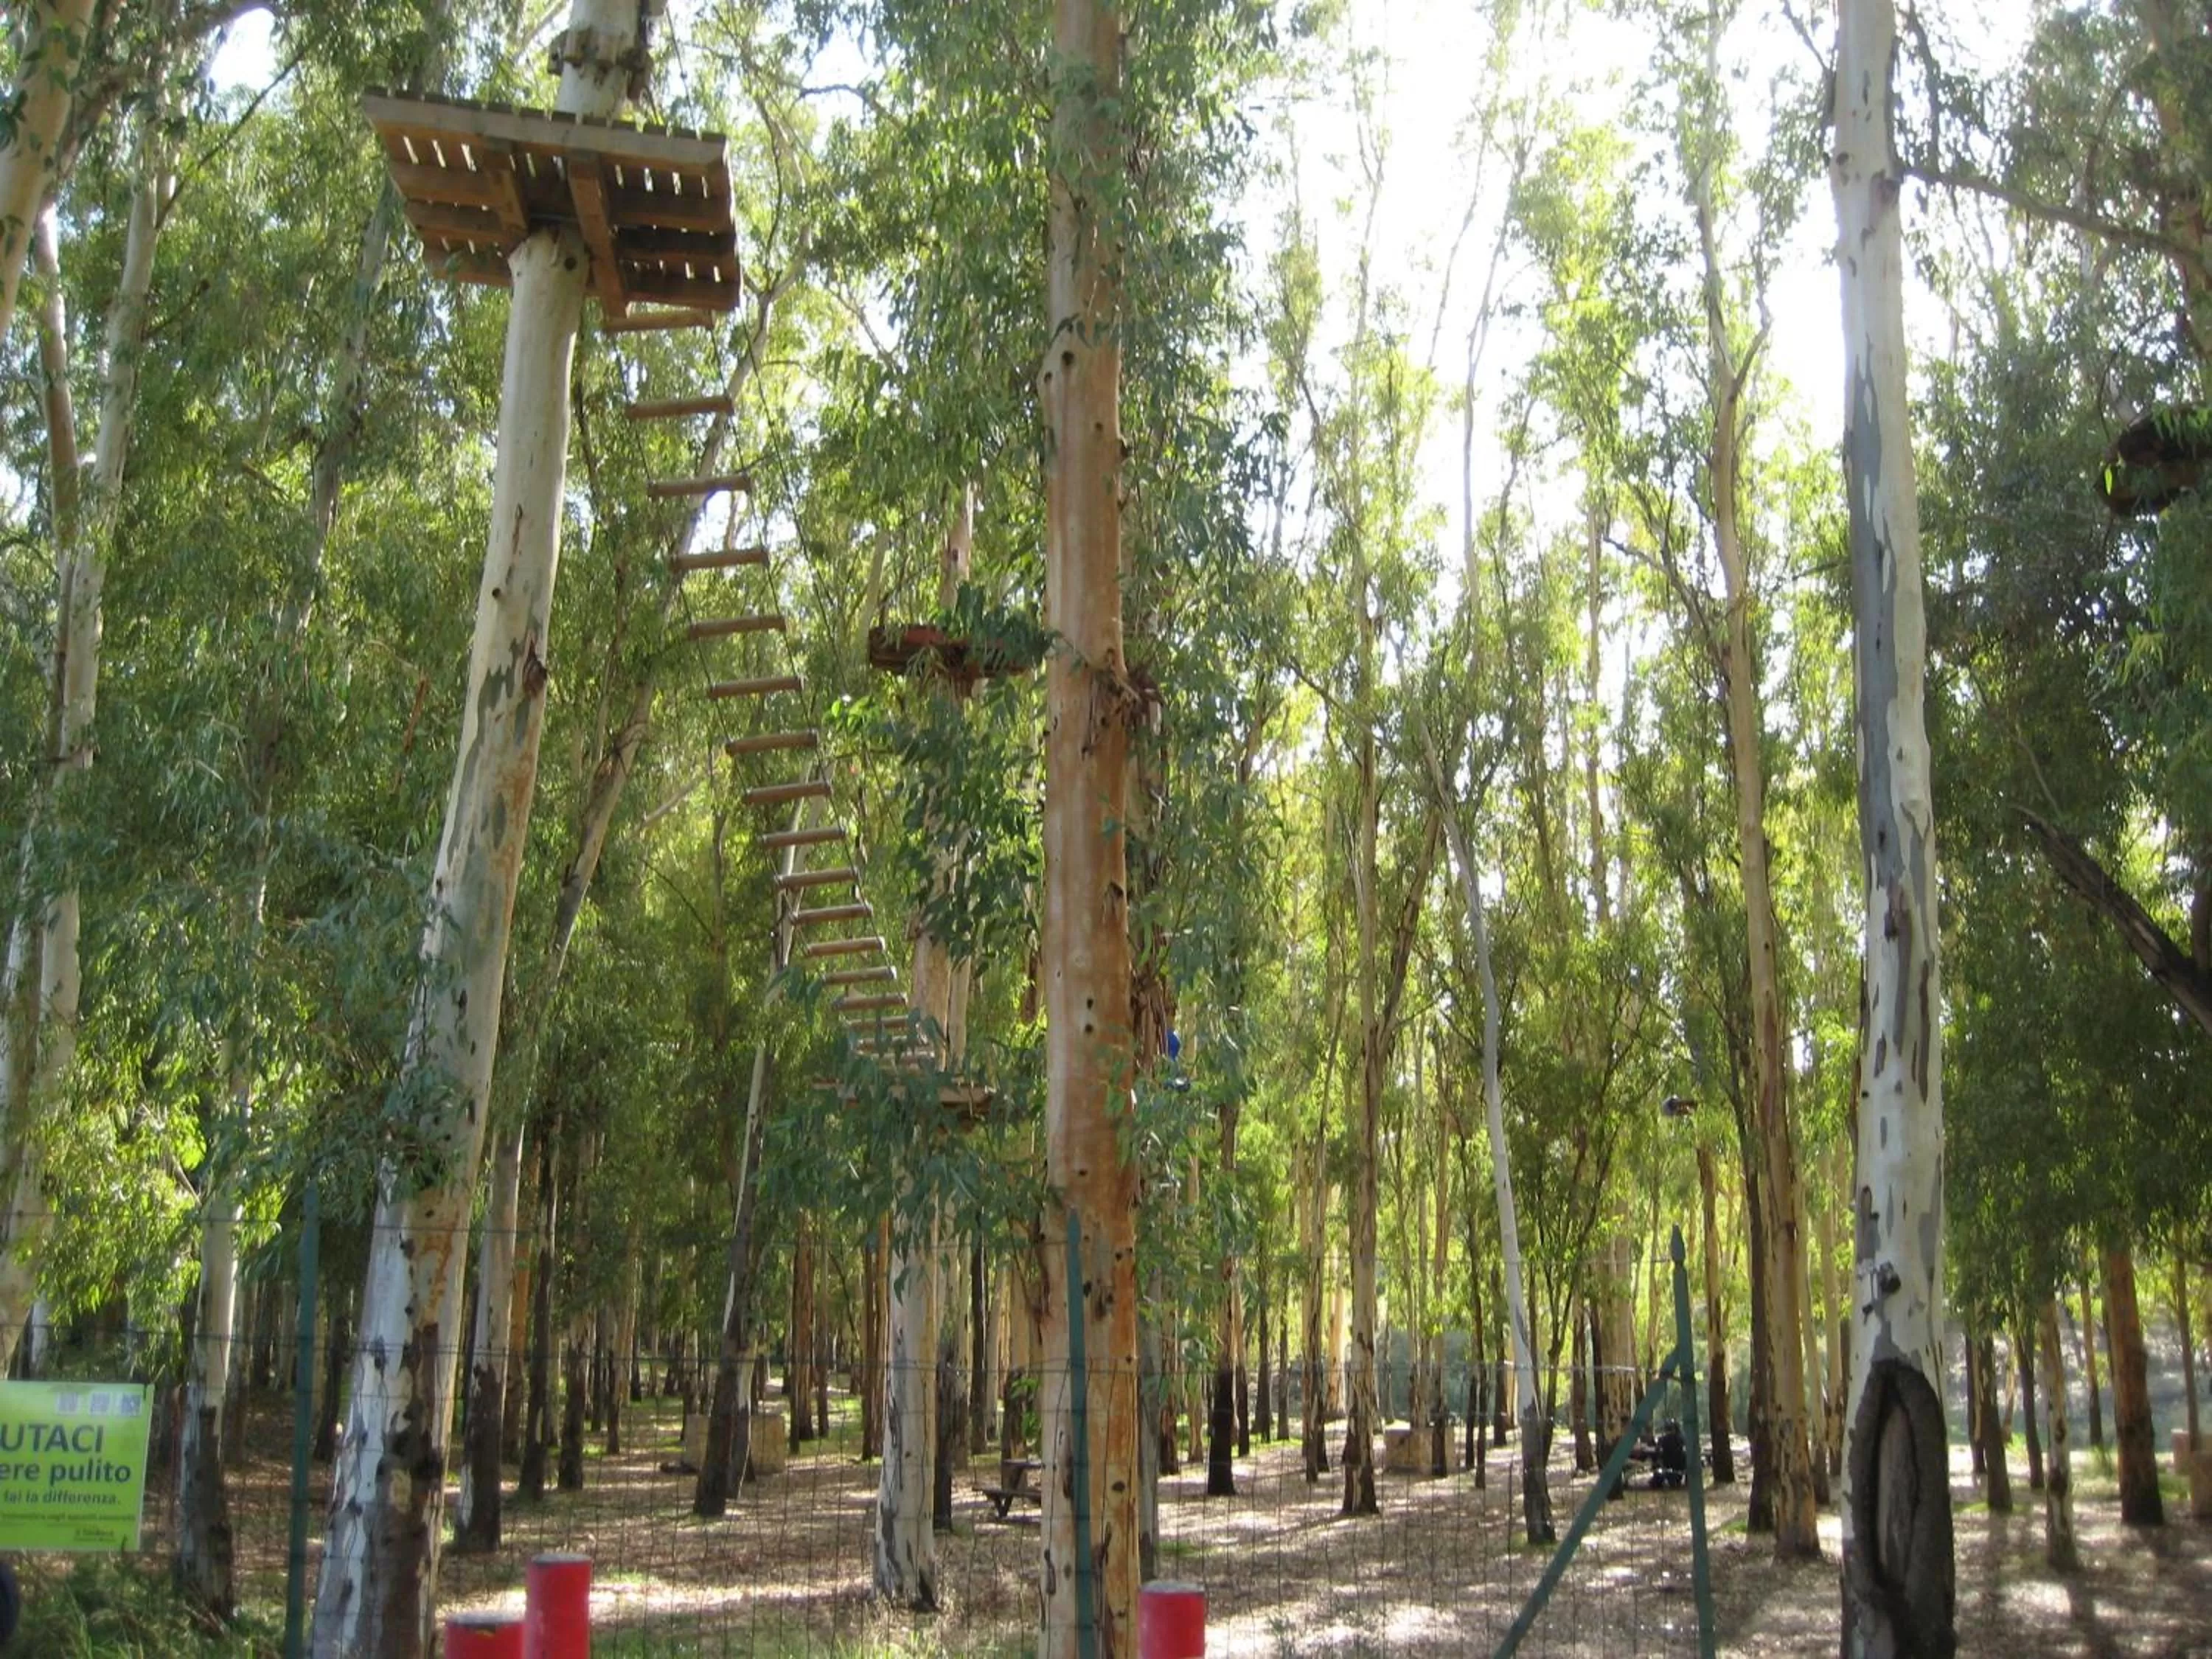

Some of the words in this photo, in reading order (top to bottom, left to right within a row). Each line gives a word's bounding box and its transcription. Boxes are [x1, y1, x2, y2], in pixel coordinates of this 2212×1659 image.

[1, 1423, 104, 1453] UTACI
[0, 1462, 40, 1481] ere
[50, 1457, 131, 1486] pulito
